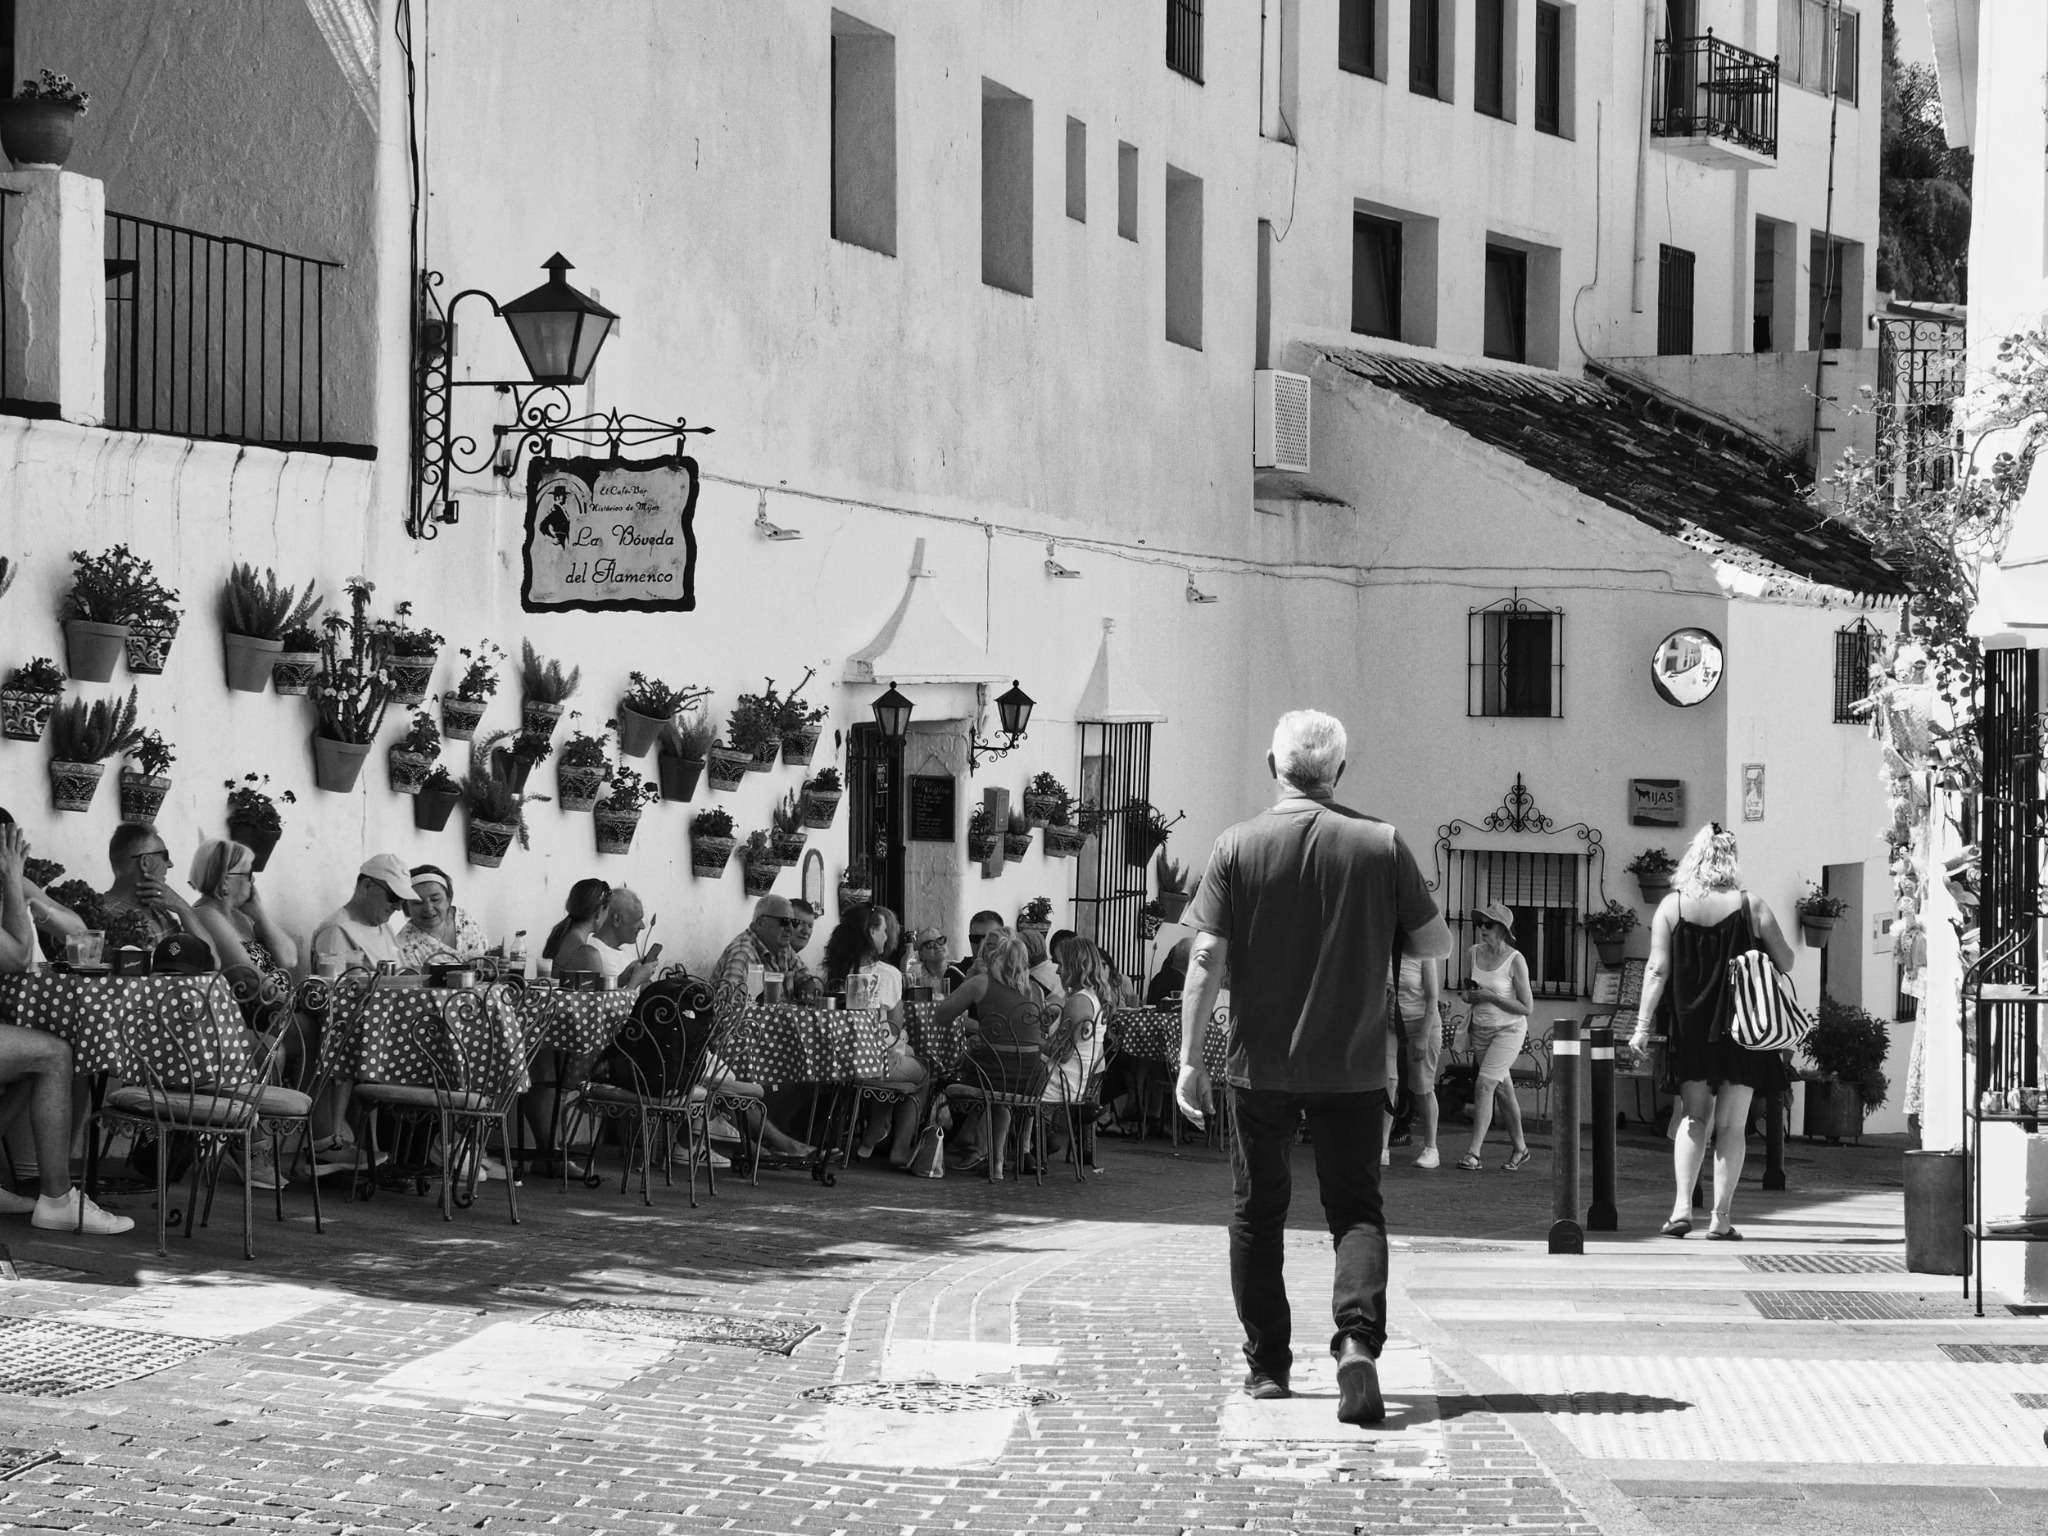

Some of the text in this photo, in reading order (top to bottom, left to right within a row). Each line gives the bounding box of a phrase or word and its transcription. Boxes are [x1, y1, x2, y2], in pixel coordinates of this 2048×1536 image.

[625, 503, 634, 511] de
[635, 501, 660, 514] Mijas
[572, 524, 674, 547] La Bóveda
[565, 558, 673, 583] del Flamenco
